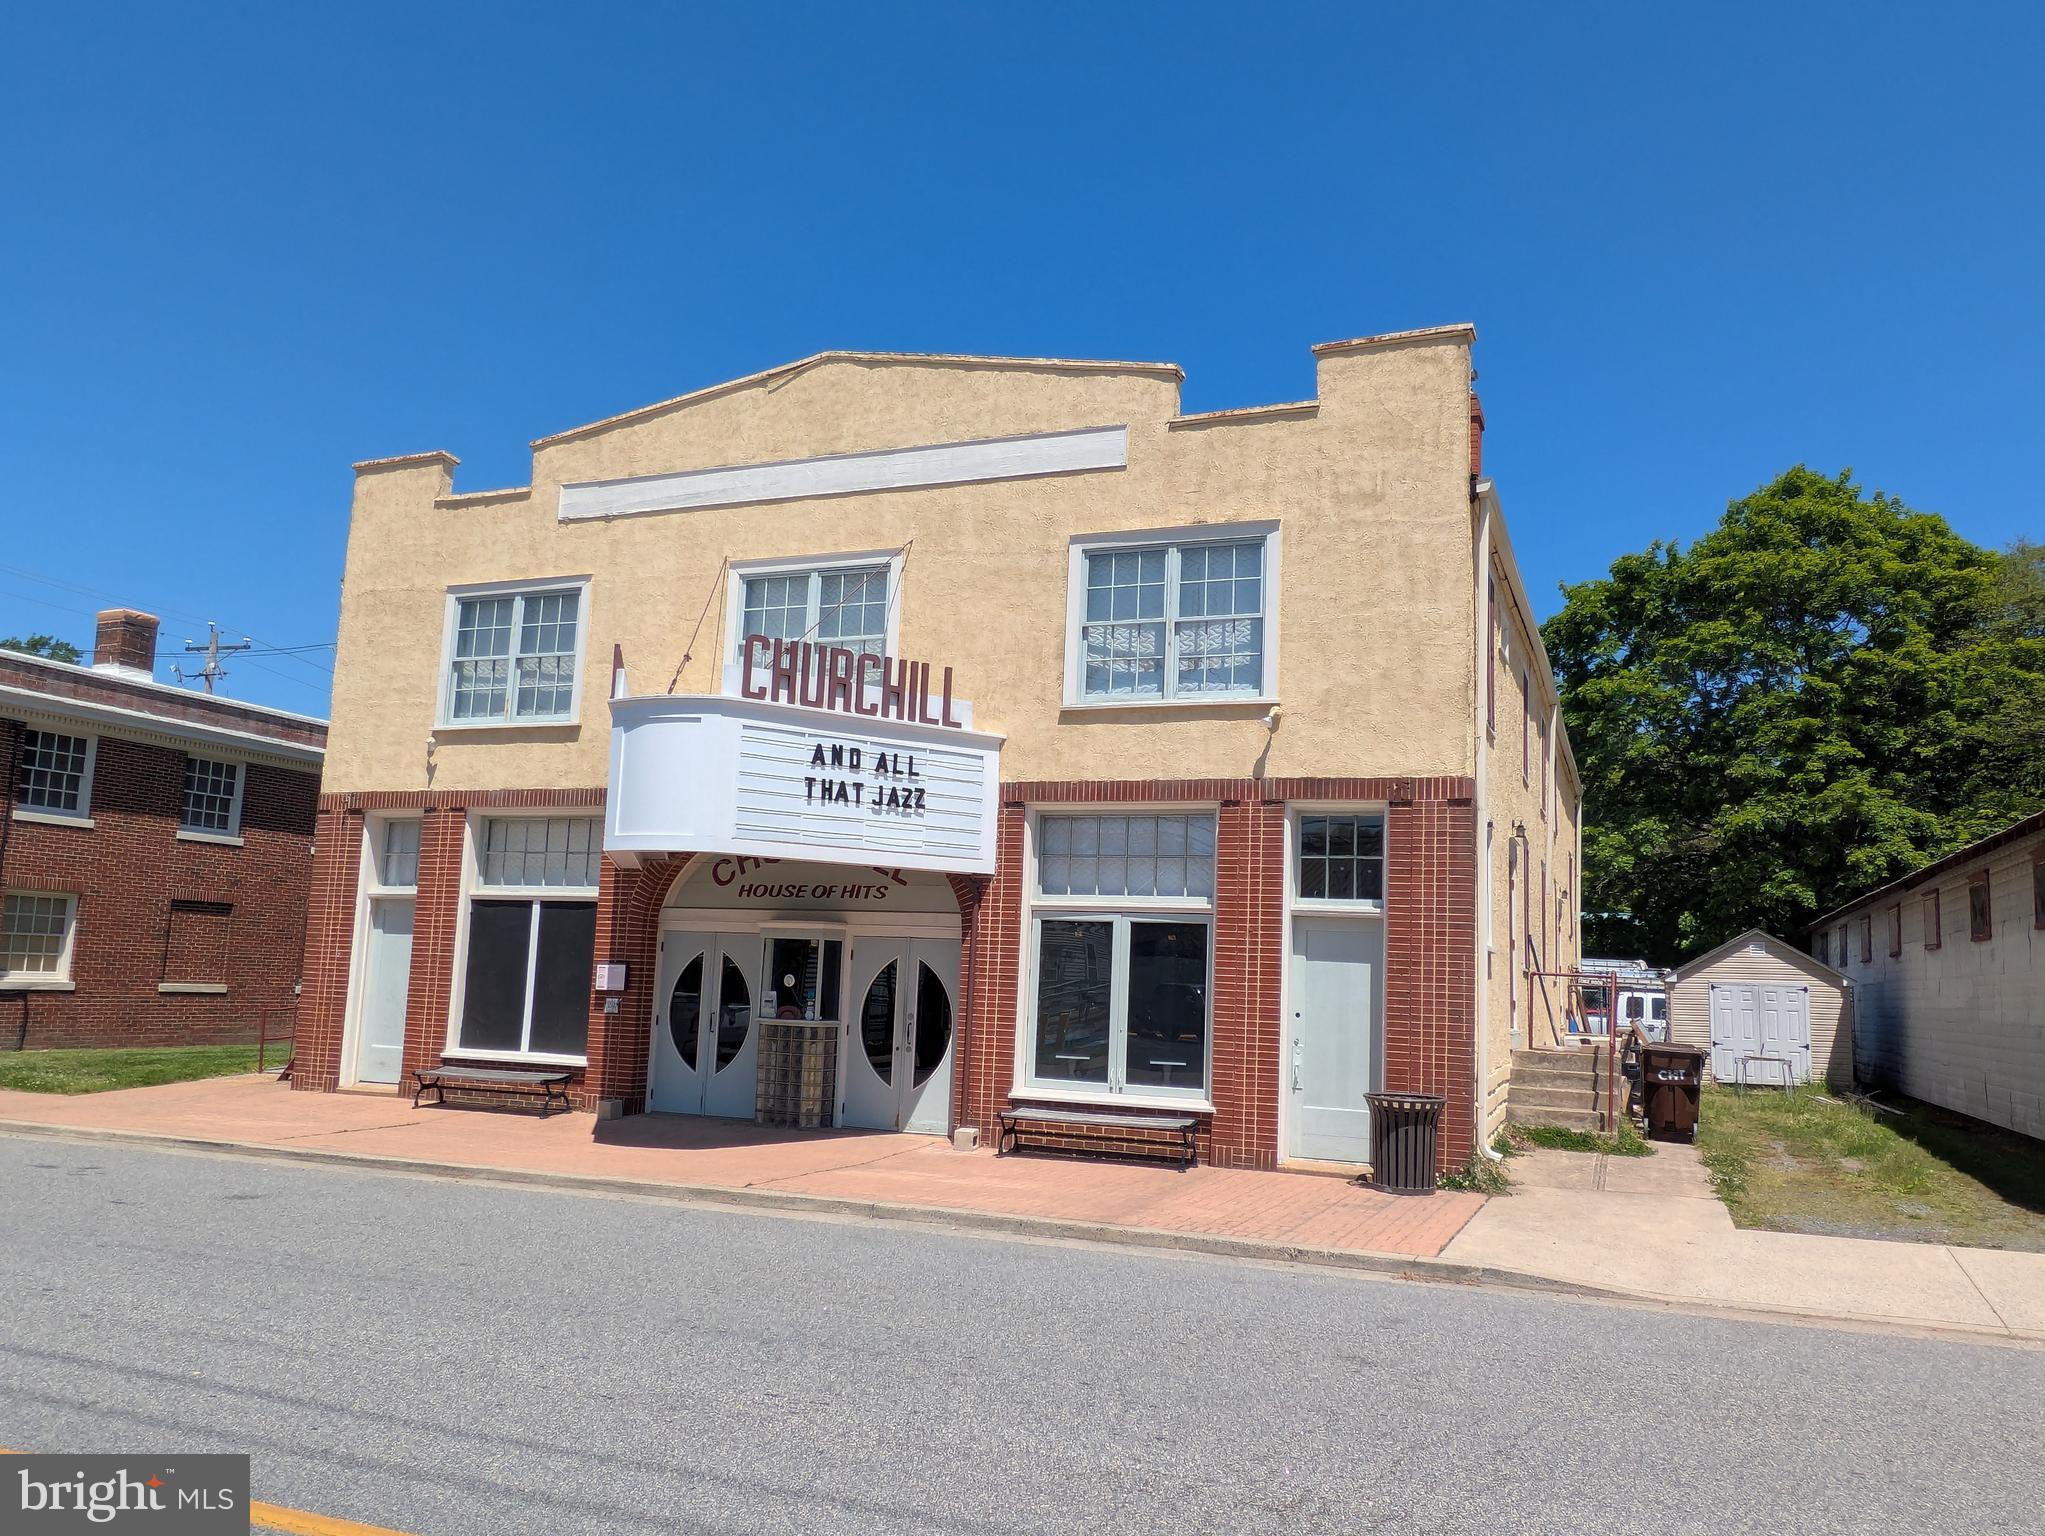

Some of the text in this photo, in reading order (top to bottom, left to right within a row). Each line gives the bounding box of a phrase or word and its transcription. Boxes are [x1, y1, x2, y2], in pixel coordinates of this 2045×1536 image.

[741, 634, 962, 729] CHURCHILL
[811, 743, 919, 776] AND ALL
[805, 777, 926, 809] THAT JAZZ
[738, 884, 889, 900] HOUSE OF HITS
